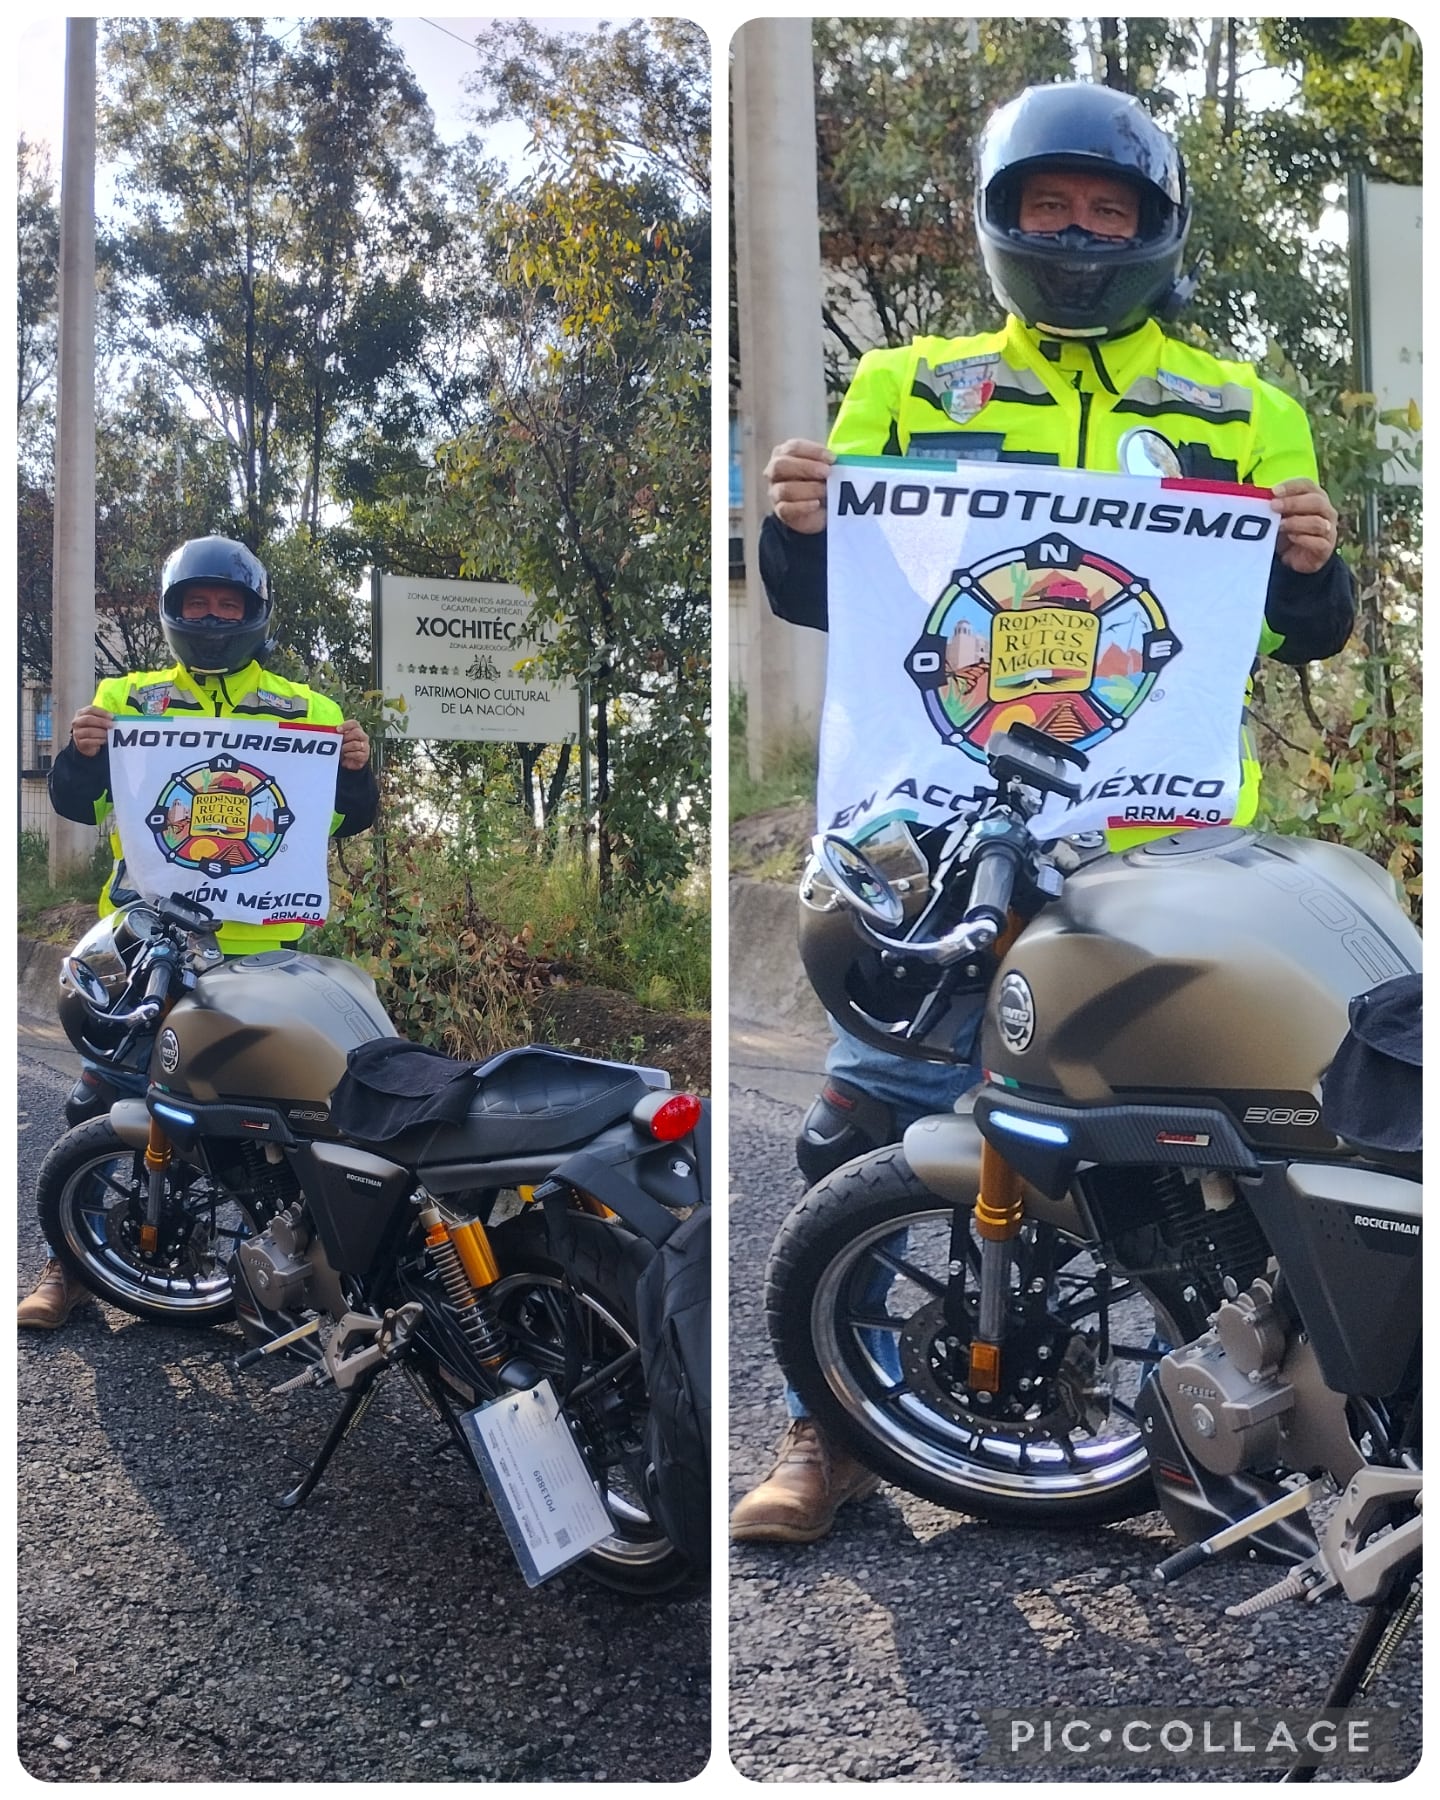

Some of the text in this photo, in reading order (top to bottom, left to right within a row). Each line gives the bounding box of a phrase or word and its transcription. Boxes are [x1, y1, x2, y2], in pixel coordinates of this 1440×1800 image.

[836, 479, 1273, 542] MOTOTURISMO
[1038, 542, 1070, 563] N
[407, 592, 429, 600] ZONA
[430, 593, 440, 601] DE
[441, 594, 494, 605] MONUMENTOS
[1148, 639, 1174, 659] E
[414, 685, 550, 702] PATRIMONIO CULTURAL
[441, 702, 525, 717] DE LA NACIÓN
[112, 728, 338, 757] MOTOTURISMO
[217, 758, 232, 769] N
[827, 790, 878, 830] EN
[1125, 806, 1222, 823] RRM 4.0
[207, 861, 223, 874] S
[236, 890, 323, 910] MÉXICO
[271, 911, 321, 920] RRM 4.0
[1243, 1107, 1319, 1126] 300
[1354, 1215, 1420, 1236] ROCKETMAN
